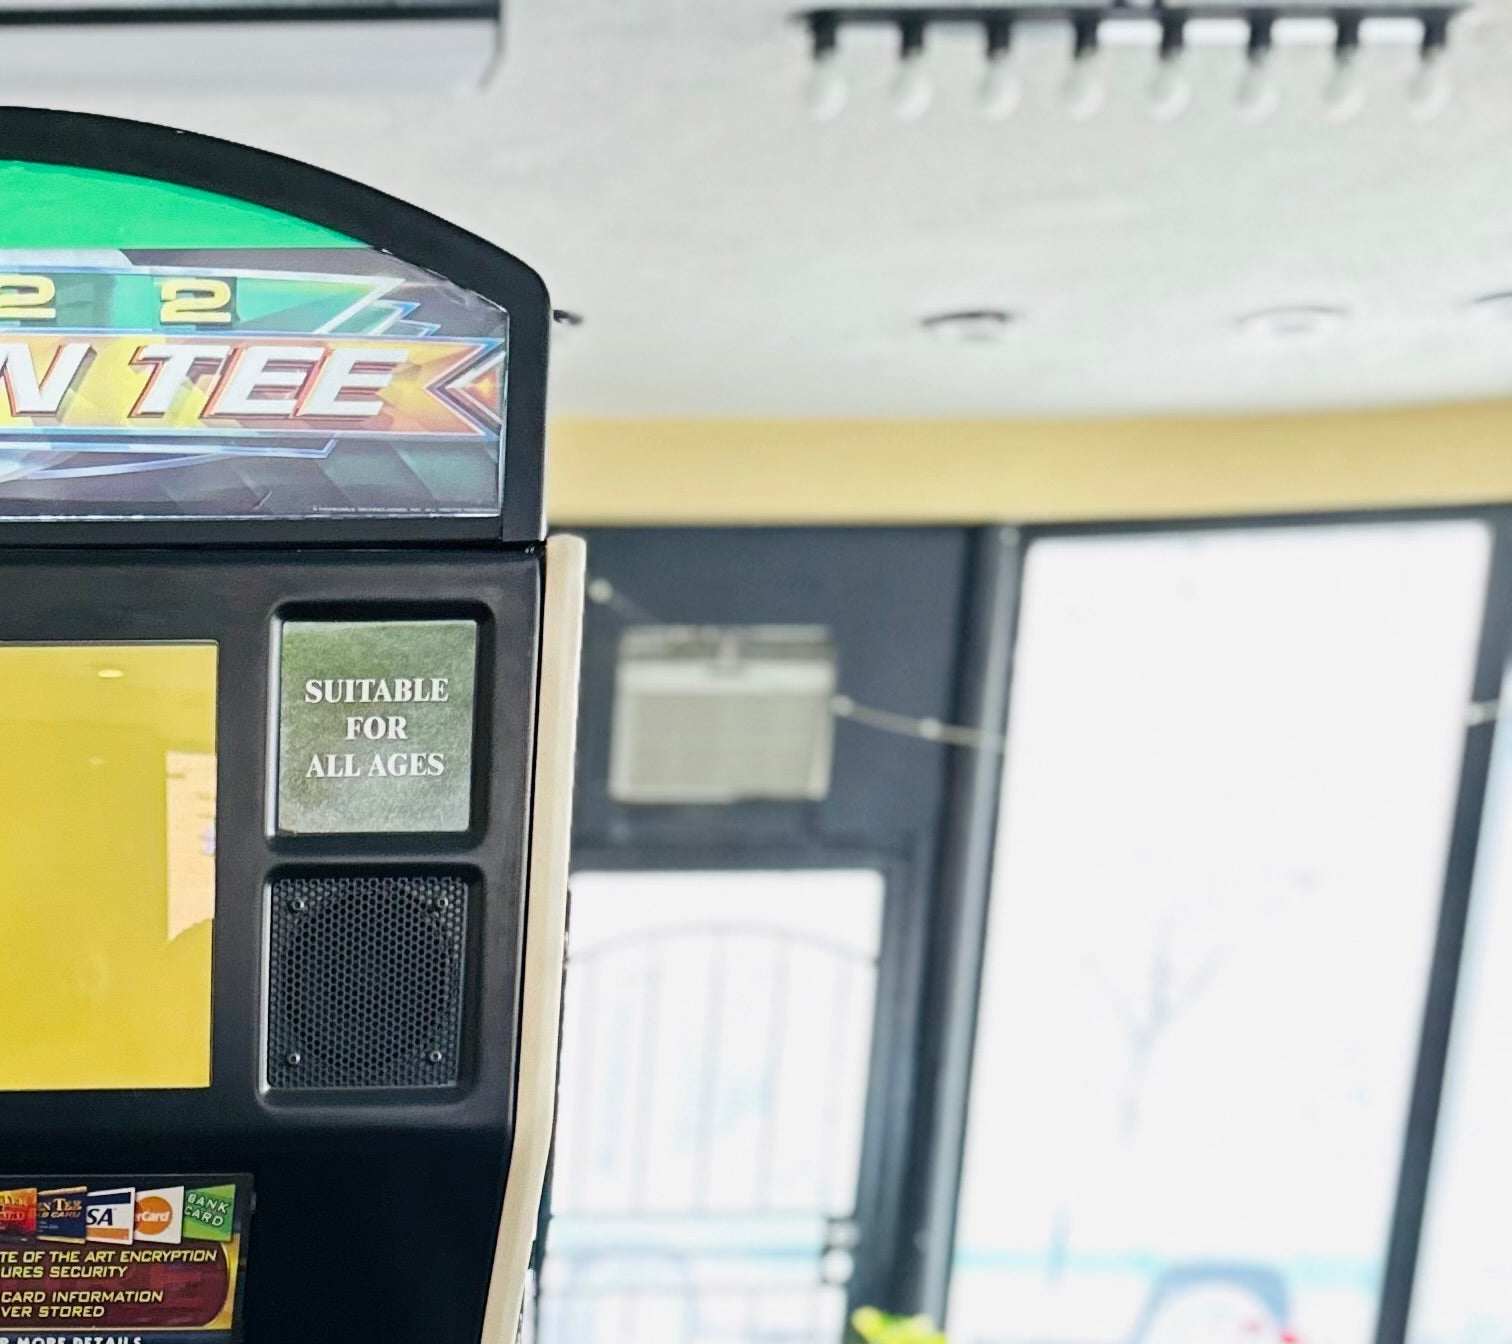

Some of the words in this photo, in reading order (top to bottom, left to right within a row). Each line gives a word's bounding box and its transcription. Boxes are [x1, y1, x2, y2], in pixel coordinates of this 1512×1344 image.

[128, 343, 410, 418] TEE
[305, 677, 449, 703] SUITABLE
[345, 716, 408, 740] FOR
[305, 754, 361, 778] ALL
[367, 753, 445, 776] AGES
[187, 1193, 230, 1214] BANK
[184, 1206, 224, 1227] CARD
[23, 1250, 44, 1263] OF
[50, 1250, 79, 1263] THE
[84, 1250, 114, 1263] ART
[119, 1249, 217, 1263] ENCRYPTION
[49, 1265, 128, 1278] SECURITY
[1, 1290, 45, 1303] CARD
[52, 1290, 164, 1303] INFORMATION
[38, 1306, 105, 1318] STORED
